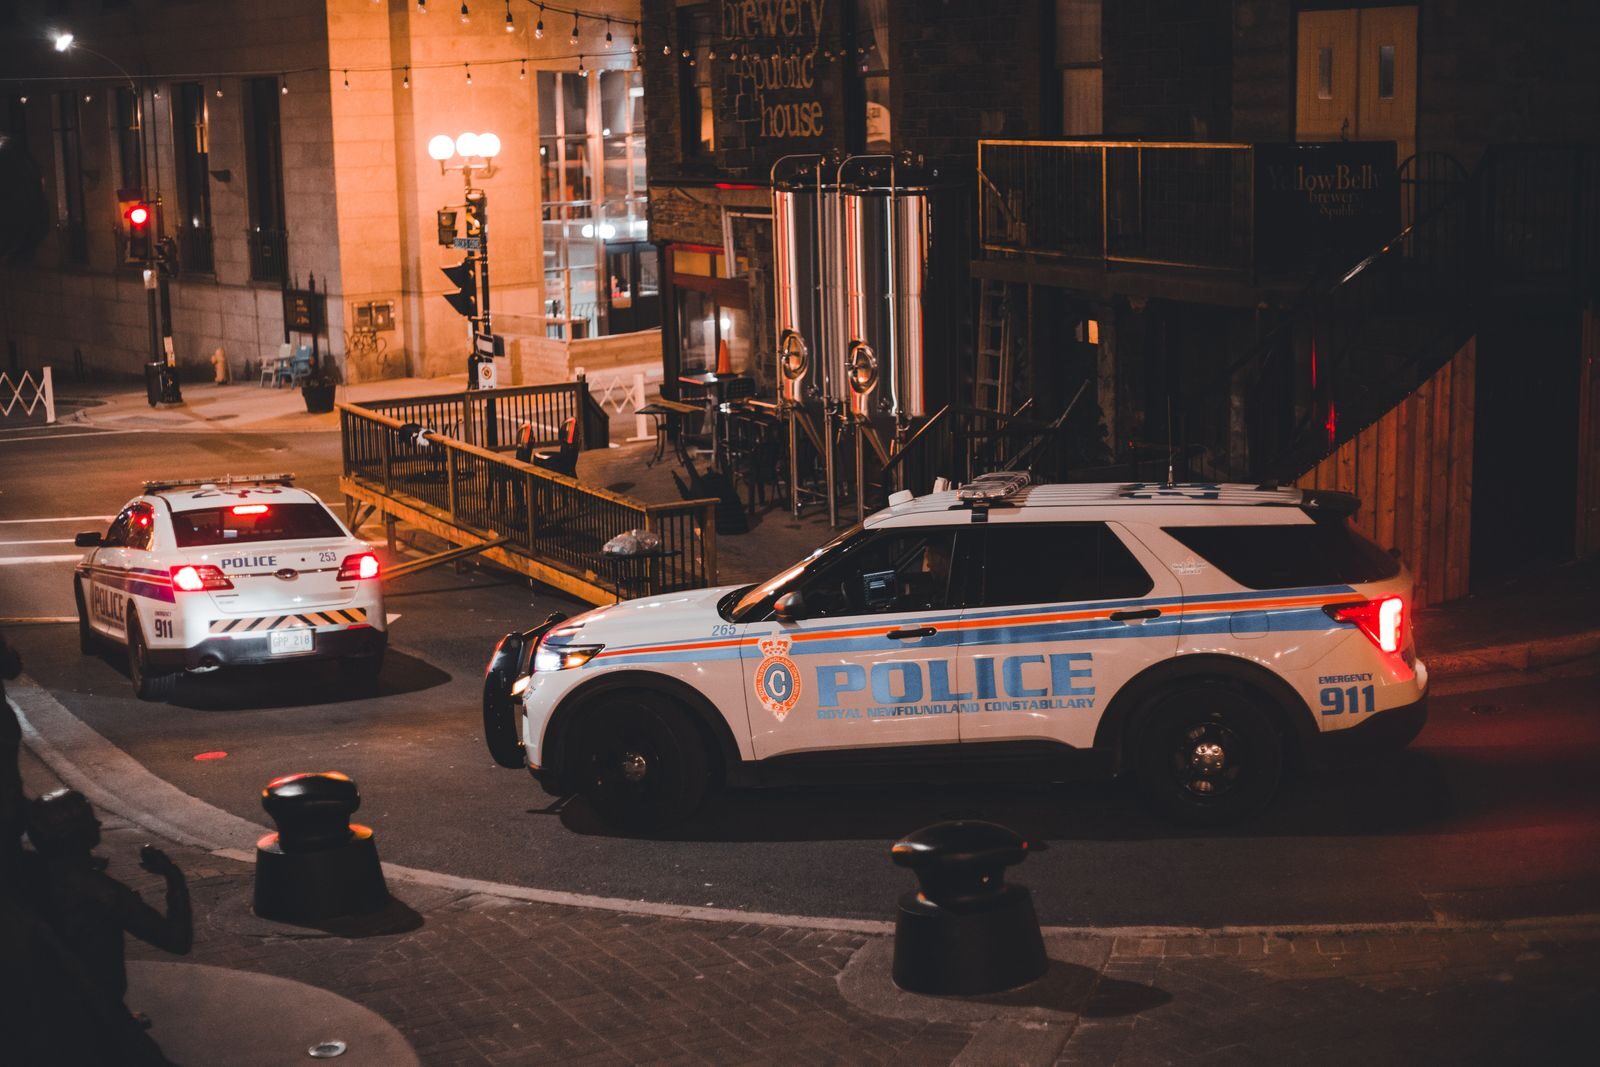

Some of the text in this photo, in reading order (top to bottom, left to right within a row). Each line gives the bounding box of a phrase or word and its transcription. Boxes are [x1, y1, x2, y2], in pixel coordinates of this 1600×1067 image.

[720, 0, 824, 53] brewery
[760, 94, 824, 138] house
[221, 555, 277, 569] POLICE
[319, 551, 337, 562] 253
[95, 586, 124, 623] POLICE
[155, 619, 173, 639] 911
[712, 624, 736, 636] 265
[768, 670, 786, 696] C
[816, 652, 1095, 707] POLICE
[1318, 673, 1373, 684] EMERGENCY
[817, 698, 1095, 719] ROYAL NEWFOUNDLAND CONSTABULARY
[1320, 684, 1375, 715] 911
